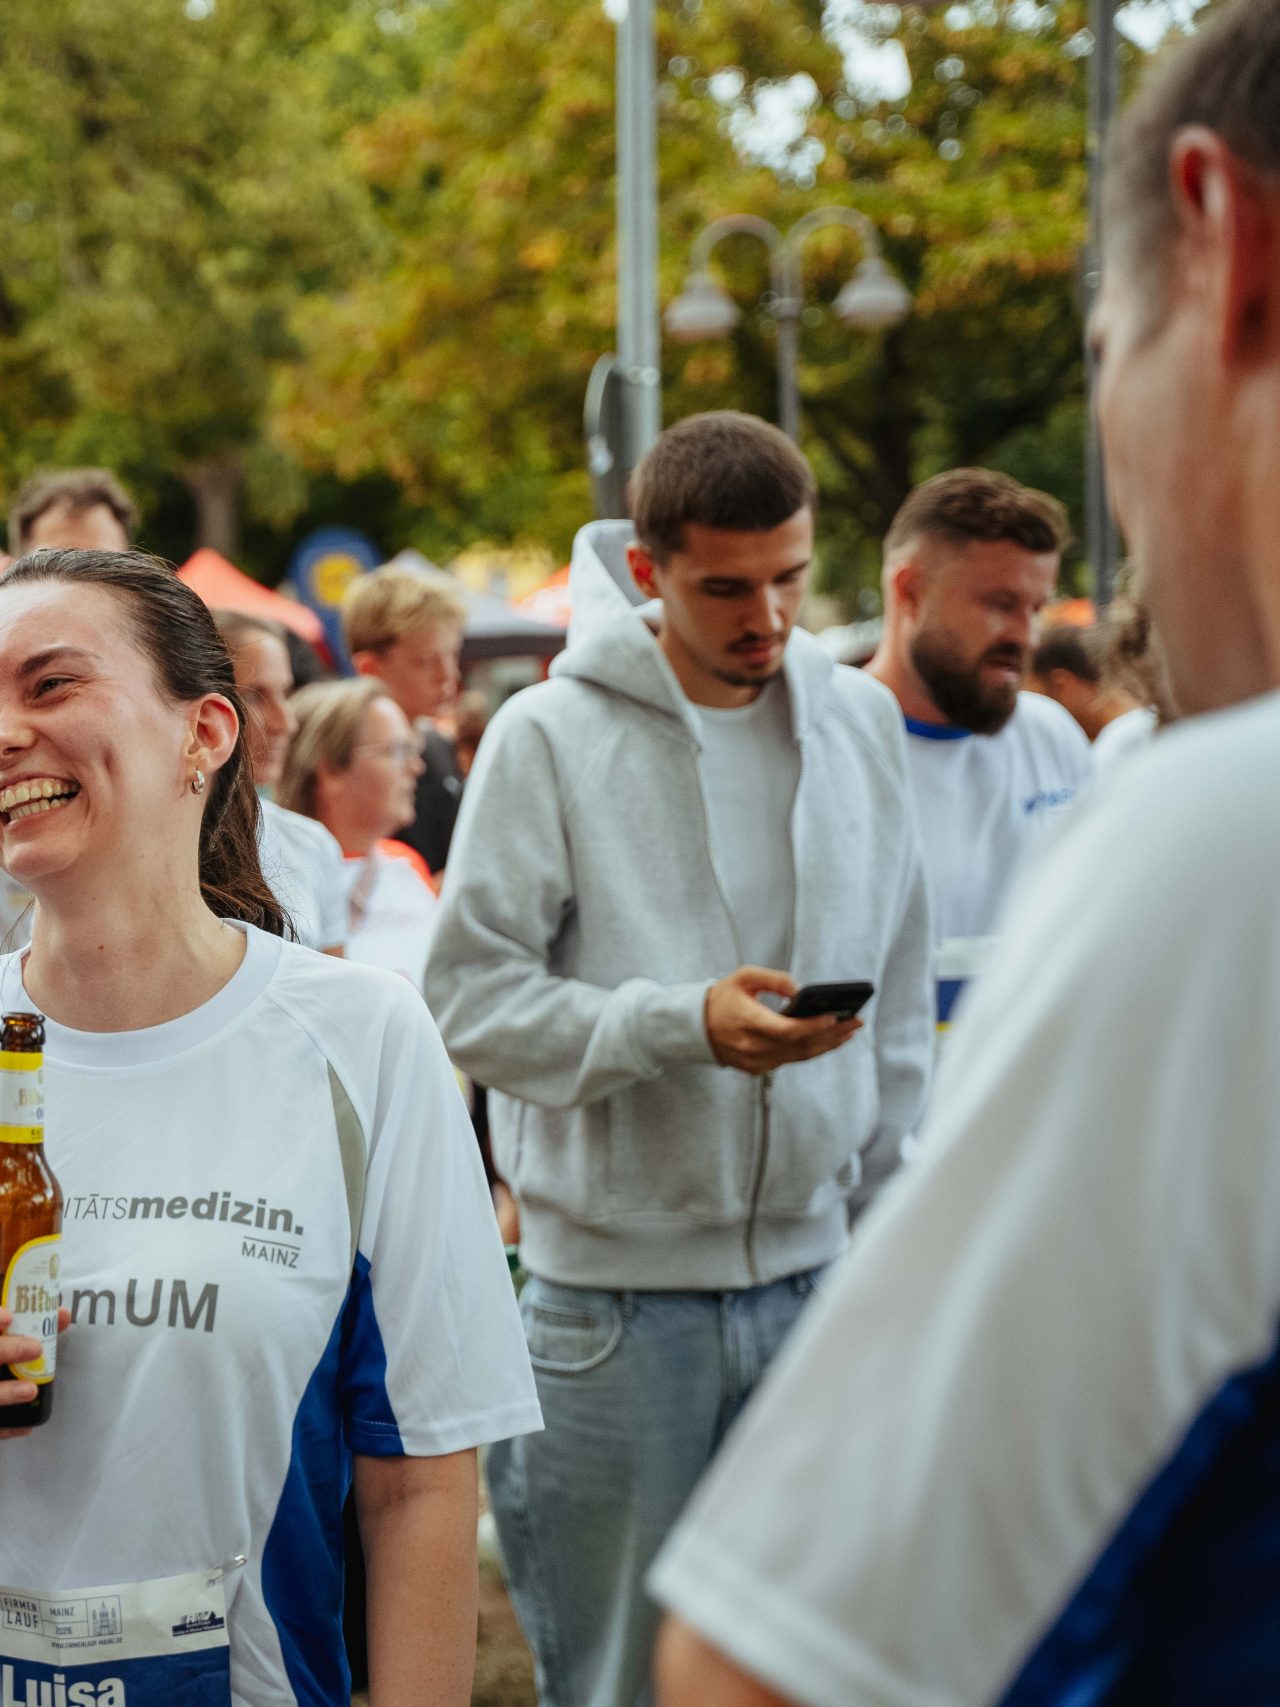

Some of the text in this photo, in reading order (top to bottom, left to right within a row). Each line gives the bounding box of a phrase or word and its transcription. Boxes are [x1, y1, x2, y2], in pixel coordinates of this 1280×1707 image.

[241, 1242, 301, 1269] MAINZ
[3, 1597, 38, 1612] FIRMEN
[49, 1606, 75, 1617] MAINZ
[6, 1610, 39, 1629] LAUF
[2, 1663, 127, 1707] Luisa
